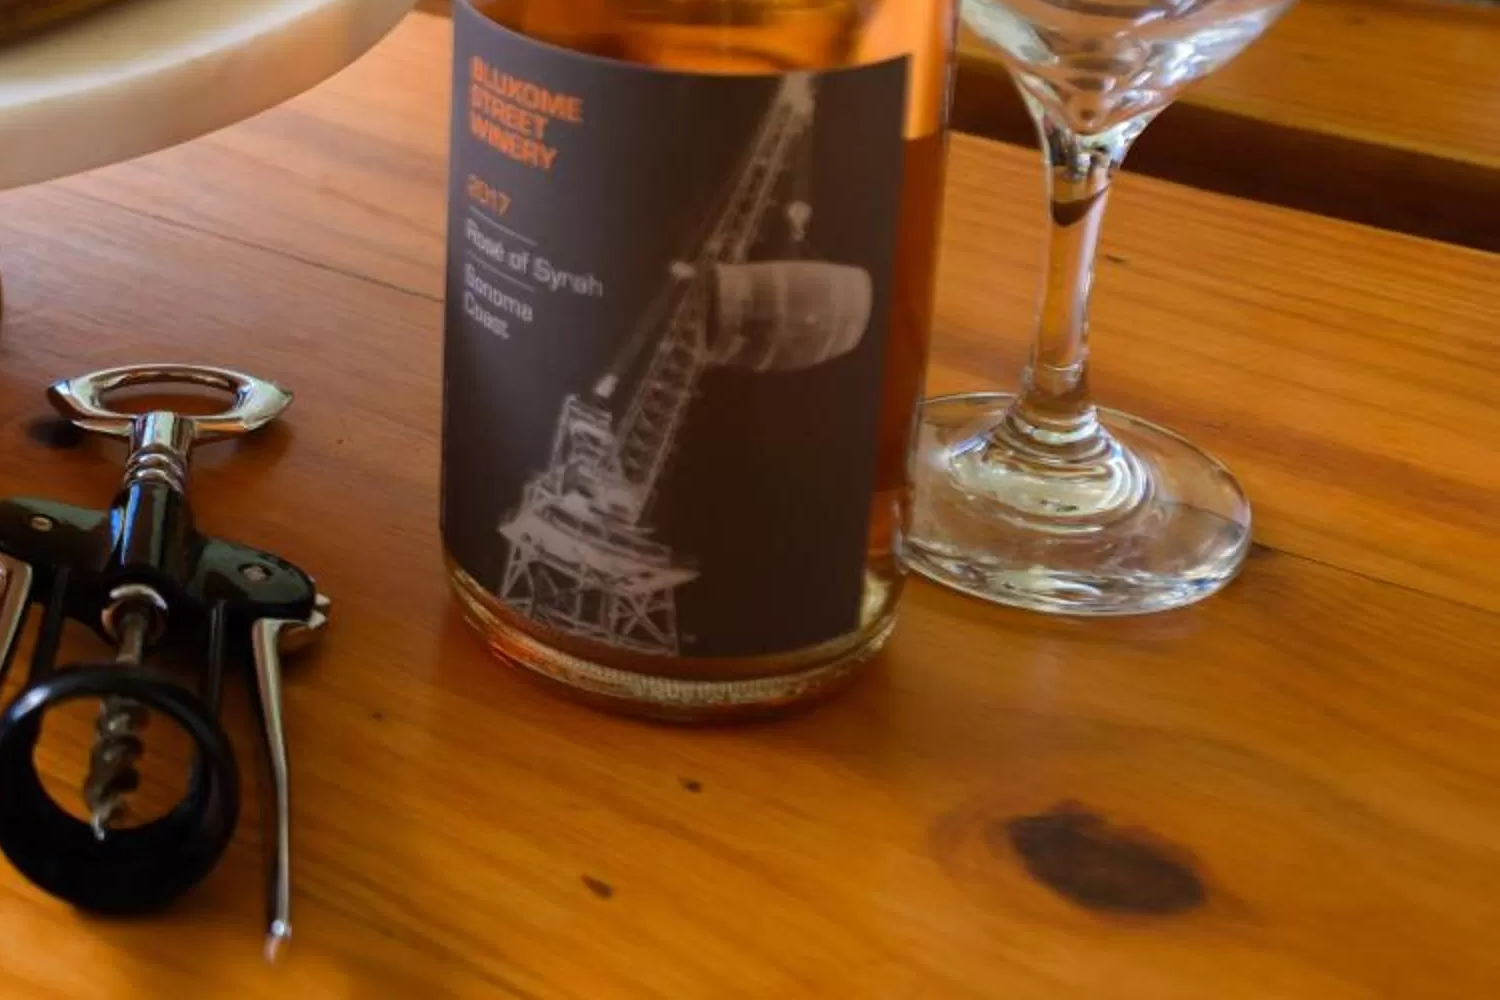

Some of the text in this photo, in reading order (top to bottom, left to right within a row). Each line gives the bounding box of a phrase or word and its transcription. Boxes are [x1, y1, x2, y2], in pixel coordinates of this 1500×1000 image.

[469, 84, 548, 140] STREET
[469, 110, 558, 169] WINERY
[467, 174, 512, 216] 2017
[465, 264, 533, 322] Sonoma
[508, 251, 531, 274] of
[533, 256, 604, 298] Syrah
[464, 292, 510, 340] Coast
